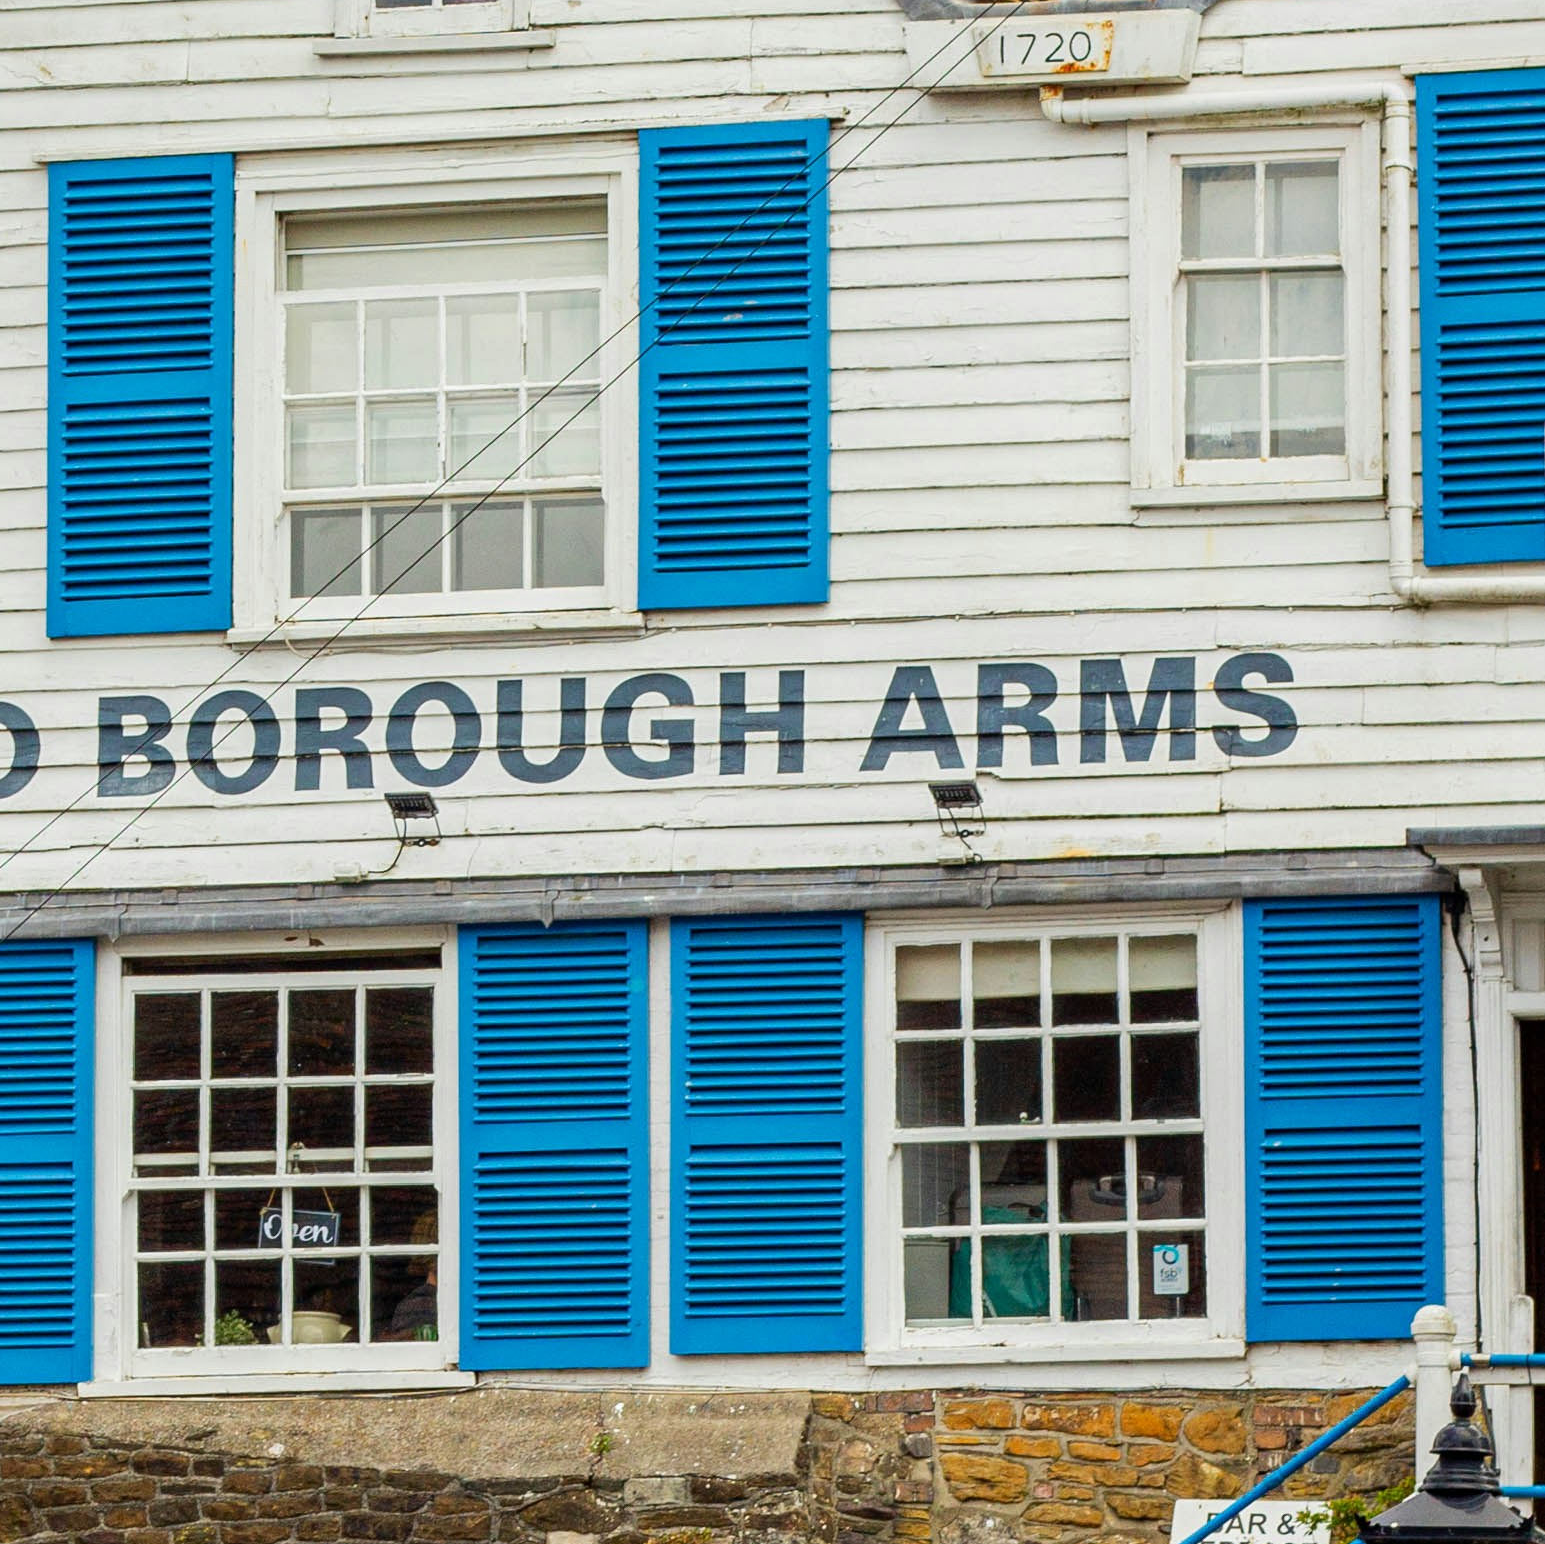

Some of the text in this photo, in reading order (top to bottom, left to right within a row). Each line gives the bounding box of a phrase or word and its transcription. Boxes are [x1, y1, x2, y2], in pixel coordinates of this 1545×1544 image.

[1000, 31, 1092, 65] 1720
[95, 667, 809, 801] BOROUGH
[858, 651, 1300, 773] ARMS
[1277, 1513, 1296, 1535] &
